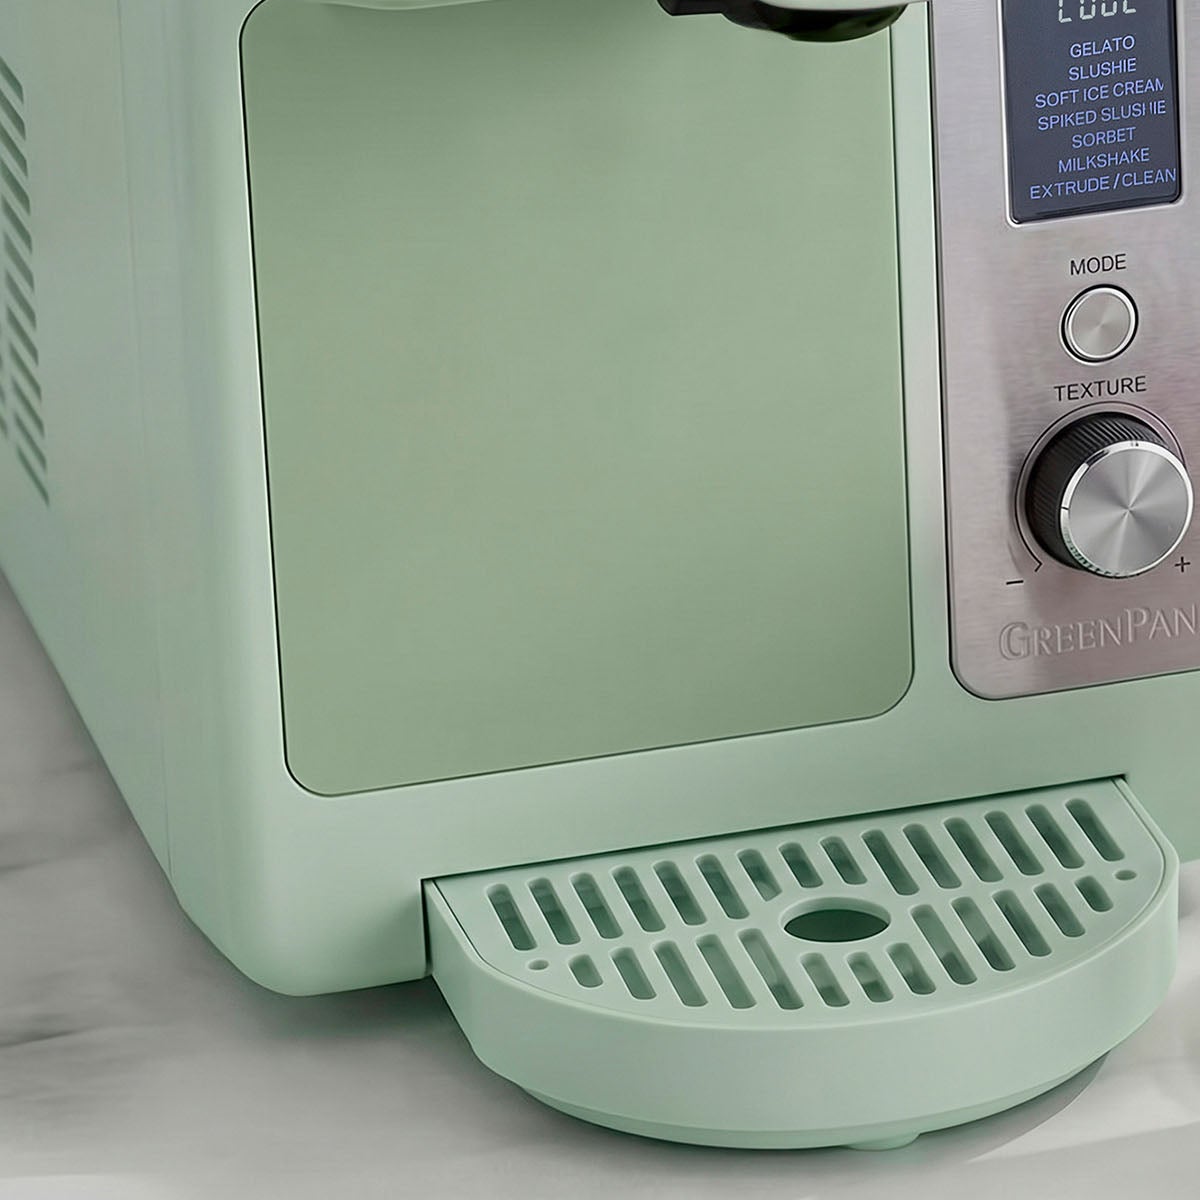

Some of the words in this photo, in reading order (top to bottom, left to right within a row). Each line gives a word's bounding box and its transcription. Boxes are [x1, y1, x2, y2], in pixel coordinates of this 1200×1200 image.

[1069, 35, 1136, 58] GELATO
[1068, 57, 1137, 81] SLUSHIE
[1035, 89, 1079, 109] SOFT
[1083, 84, 1110, 102] ICE
[1038, 110, 1097, 131] SPIKED
[1072, 126, 1136, 149] SORBET
[1058, 147, 1150, 173] MILKSHAKE
[1070, 253, 1127, 276] MODE
[1053, 375, 1148, 402] TEXTURE
